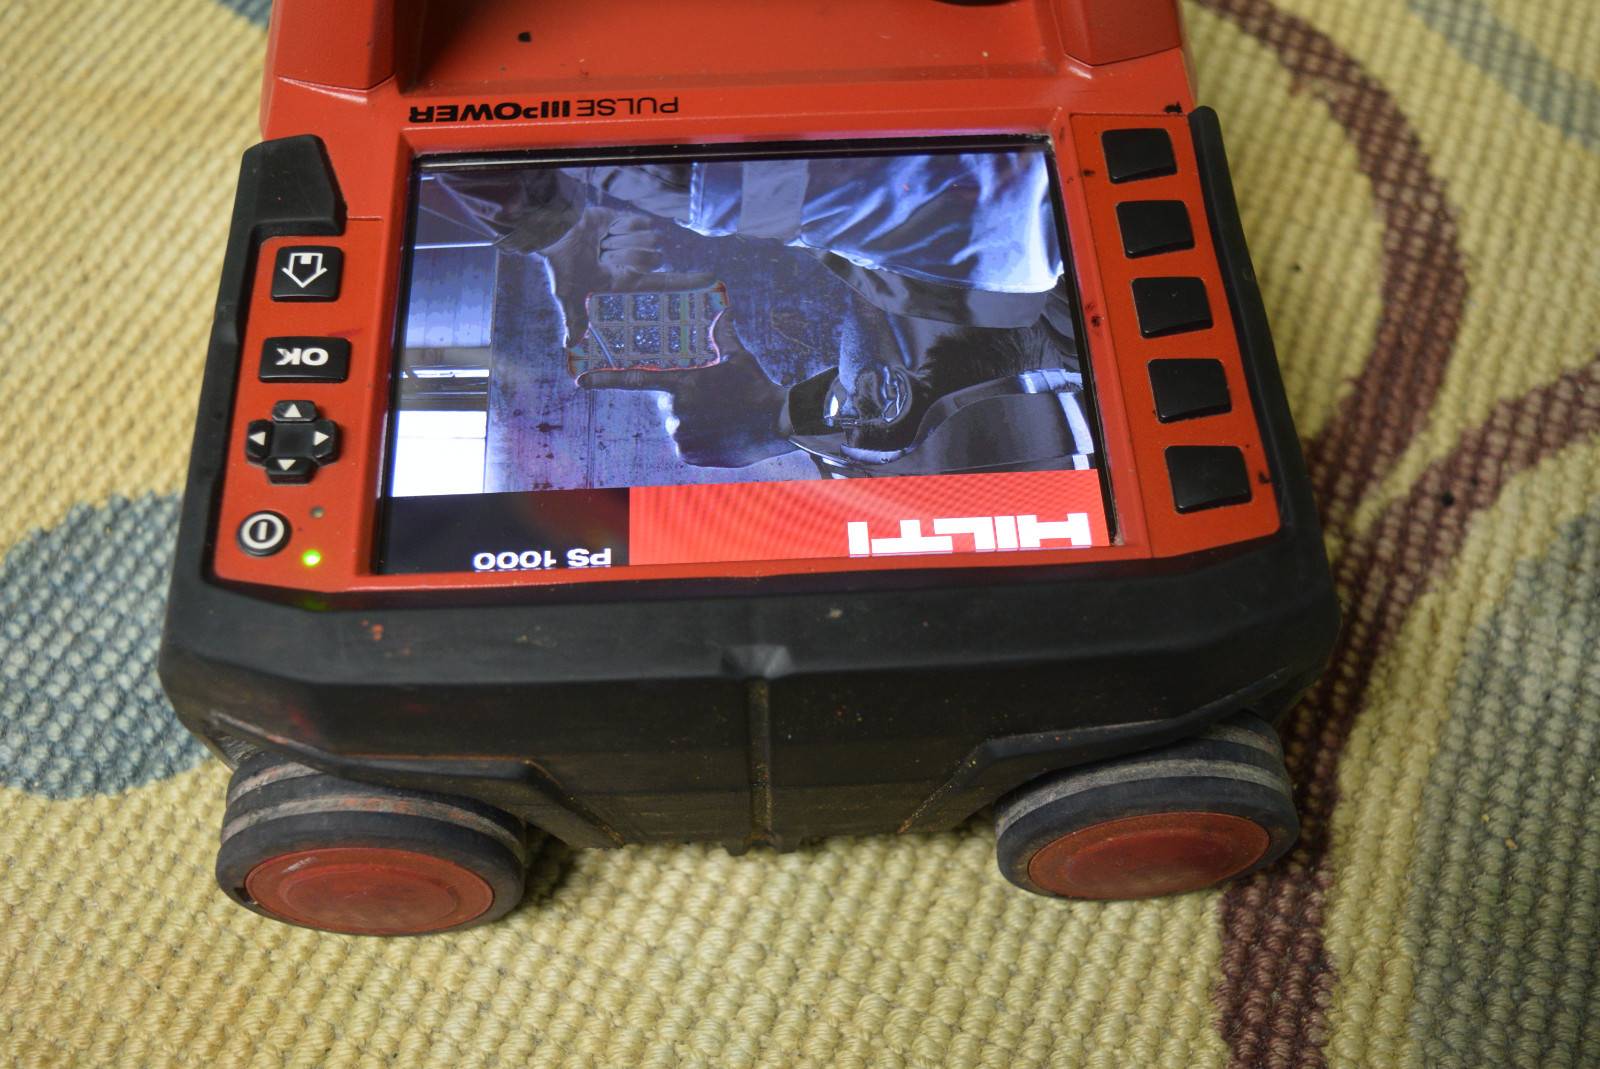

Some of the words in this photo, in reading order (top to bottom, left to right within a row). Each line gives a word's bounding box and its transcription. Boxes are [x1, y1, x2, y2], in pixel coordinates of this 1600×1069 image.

[576, 96, 679, 117] PULSE
[275, 347, 329, 366] OK
[847, 512, 1092, 556] HILTI
[473, 550, 557, 570] 1000
[566, 548, 612, 567] PS
